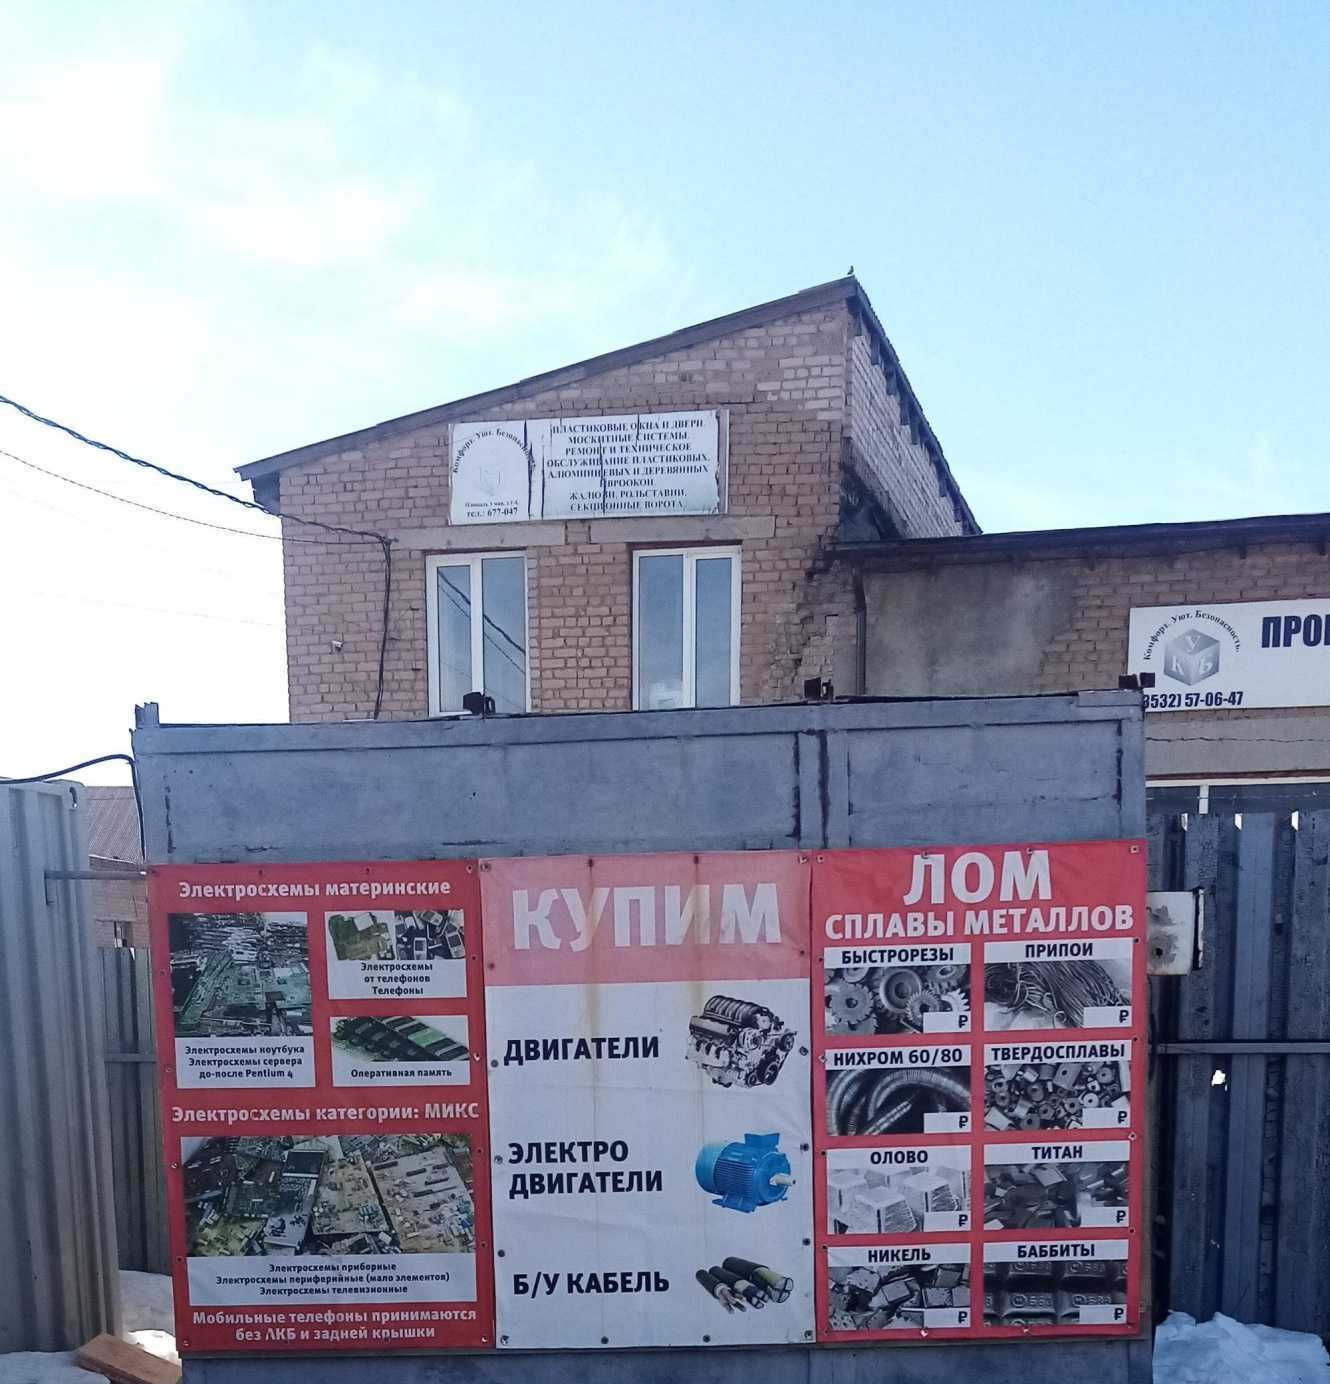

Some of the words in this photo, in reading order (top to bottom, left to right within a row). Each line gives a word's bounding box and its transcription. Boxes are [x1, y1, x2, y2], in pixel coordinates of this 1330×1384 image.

[552, 423, 628, 434] ПЛАСТИКОВЫЕ
[630, 421, 659, 430] ОКНА
[662, 420, 669, 429] И
[568, 433, 632, 444] МОСКИТНЫЕ
[636, 431, 687, 441] СИСТЕМЫ
[566, 446, 607, 456] РЕМОНТ
[609, 446, 616, 454] И
[620, 443, 692, 453] ТЕХНИЧЕСКОЕ
[546, 456, 628, 467] ОБСЛУЖИВАНИЕ
[548, 468, 630, 479] АЛЮМИНИЕВЫХ
[633, 467, 640, 475] И
[642, 465, 709, 475] ДЕРЕВЯННЫХ
[570, 501, 640, 511] СЕКЦИОННЫЕ
[644, 500, 683, 509] ВОРОТА
[1261, 613, 1330, 648] ПРО
[1184, 690, 1244, 707] 57-06-47
[903, 850, 1052, 906] ЛОМ
[179, 881, 320, 901] Электросхемы
[325, 880, 451, 899] материнские
[512, 882, 782, 952] КУПИМ
[825, 910, 954, 940] СПЛАВЫ
[964, 905, 1134, 936] МЕТАЛЛОВ
[841, 947, 954, 965] БЫСТРОРЕЗЫ
[1025, 942, 1094, 959] ПРИПОИ
[361, 962, 433, 973] Электросхемы
[364, 975, 374, 983] от
[377, 973, 431, 984] телефонов
[372, 986, 424, 996] Телефоны
[185, 1046, 257, 1056] Электросхемы
[259, 1044, 305, 1056] ноутбука
[503, 1036, 660, 1066] ДВИГАТЕЛИ
[833, 1049, 903, 1067] НИХРОМ
[908, 1047, 963, 1065] 60/80
[991, 1044, 1126, 1063] ТВЕРДОСПЛАВЫ
[188, 1057, 261, 1068] Электросхемы
[263, 1057, 303, 1067] сервера
[199, 1069, 243, 1080] до-после
[245, 1068, 285, 1078] Pentium
[287, 1069, 293, 1079] 4
[351, 1069, 415, 1079] Оперативная
[417, 1068, 453, 1077] память
[171, 1105, 310, 1125] Электросхемы
[314, 1105, 420, 1123] категории:
[424, 1102, 481, 1119] МИКС
[508, 1140, 629, 1165] ЭЛЕКТРО
[870, 1150, 928, 1165] ОЛОВО
[1031, 1145, 1083, 1160] ТИТАН
[508, 1170, 663, 1199] ДВИГАТЕЛИ
[868, 1248, 931, 1263] НИКЕЛЬ
[1017, 1244, 1095, 1259] БАББИТЫ
[269, 1263, 340, 1274] Электросхемы
[341, 1262, 397, 1272] приборные
[215, 1276, 287, 1286] Электросхемы
[289, 1273, 364, 1285] периферийные
[366, 1273, 394, 1283] (мало
[396, 1271, 450, 1283] элементов)
[513, 1272, 560, 1299] Б/У
[567, 1271, 670, 1294] КАБЕЛЬ
[259, 1286, 330, 1297] Электросхемы
[332, 1285, 408, 1294] телевизионные
[192, 1311, 286, 1325] Мобильные
[288, 1309, 368, 1326] телефоны
[372, 1308, 477, 1324] принимаются
[235, 1327, 262, 1341] без
[300, 1329, 310, 1340] и
[313, 1326, 369, 1342] задней
[372, 1326, 435, 1342] крышки
